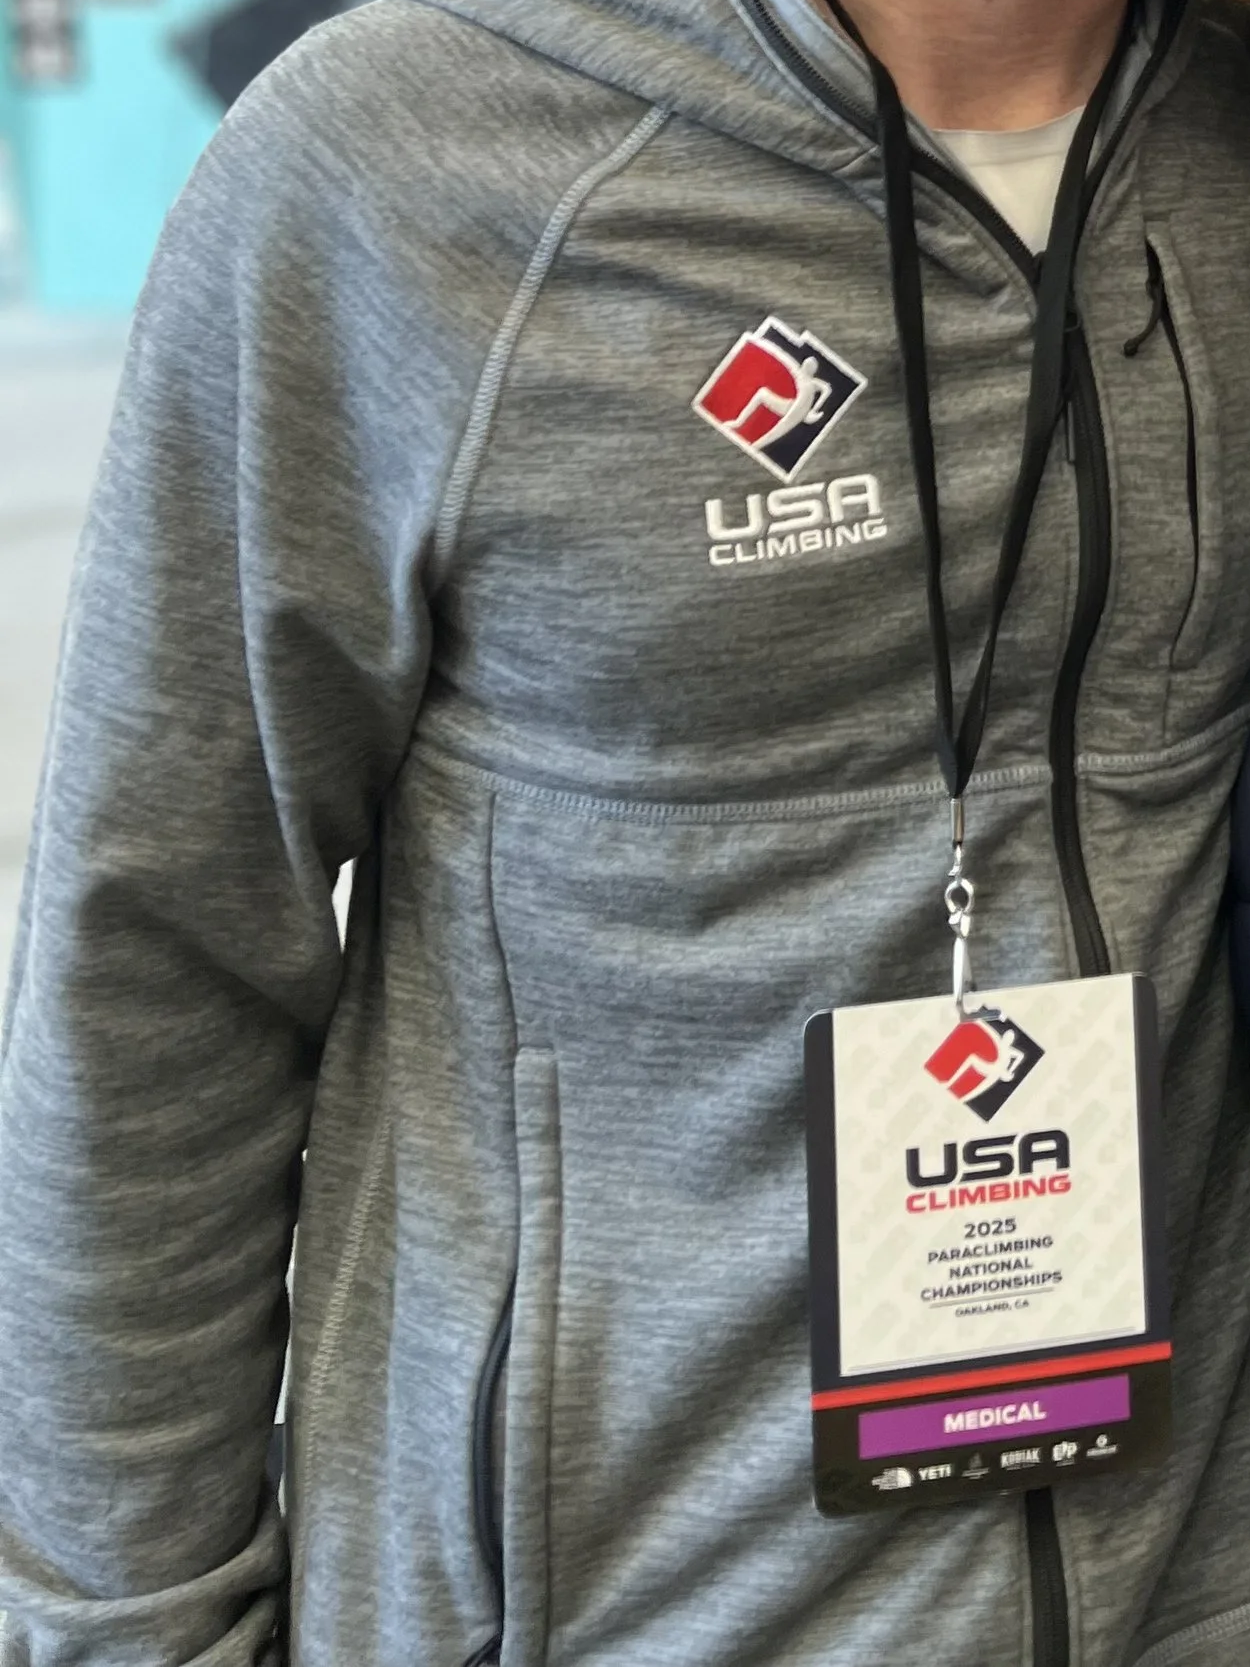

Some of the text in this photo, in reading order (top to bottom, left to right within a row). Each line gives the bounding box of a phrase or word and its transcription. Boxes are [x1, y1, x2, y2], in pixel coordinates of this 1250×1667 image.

[704, 474, 881, 540] USA
[708, 518, 887, 566] CLIMBING
[905, 1129, 1070, 1188] USA
[905, 1174, 1071, 1213] CLIMBING
[964, 1218, 1017, 1239] 2025
[927, 1236, 1053, 1264] PARACLIMBING
[949, 1257, 1033, 1278] NATIONAL
[920, 1270, 1062, 1302] CHAMPIONSHIPS
[955, 1299, 1029, 1317] OAKLAND, CA
[944, 1403, 1046, 1434] MEDICAL
[918, 1464, 952, 1481] YETI
